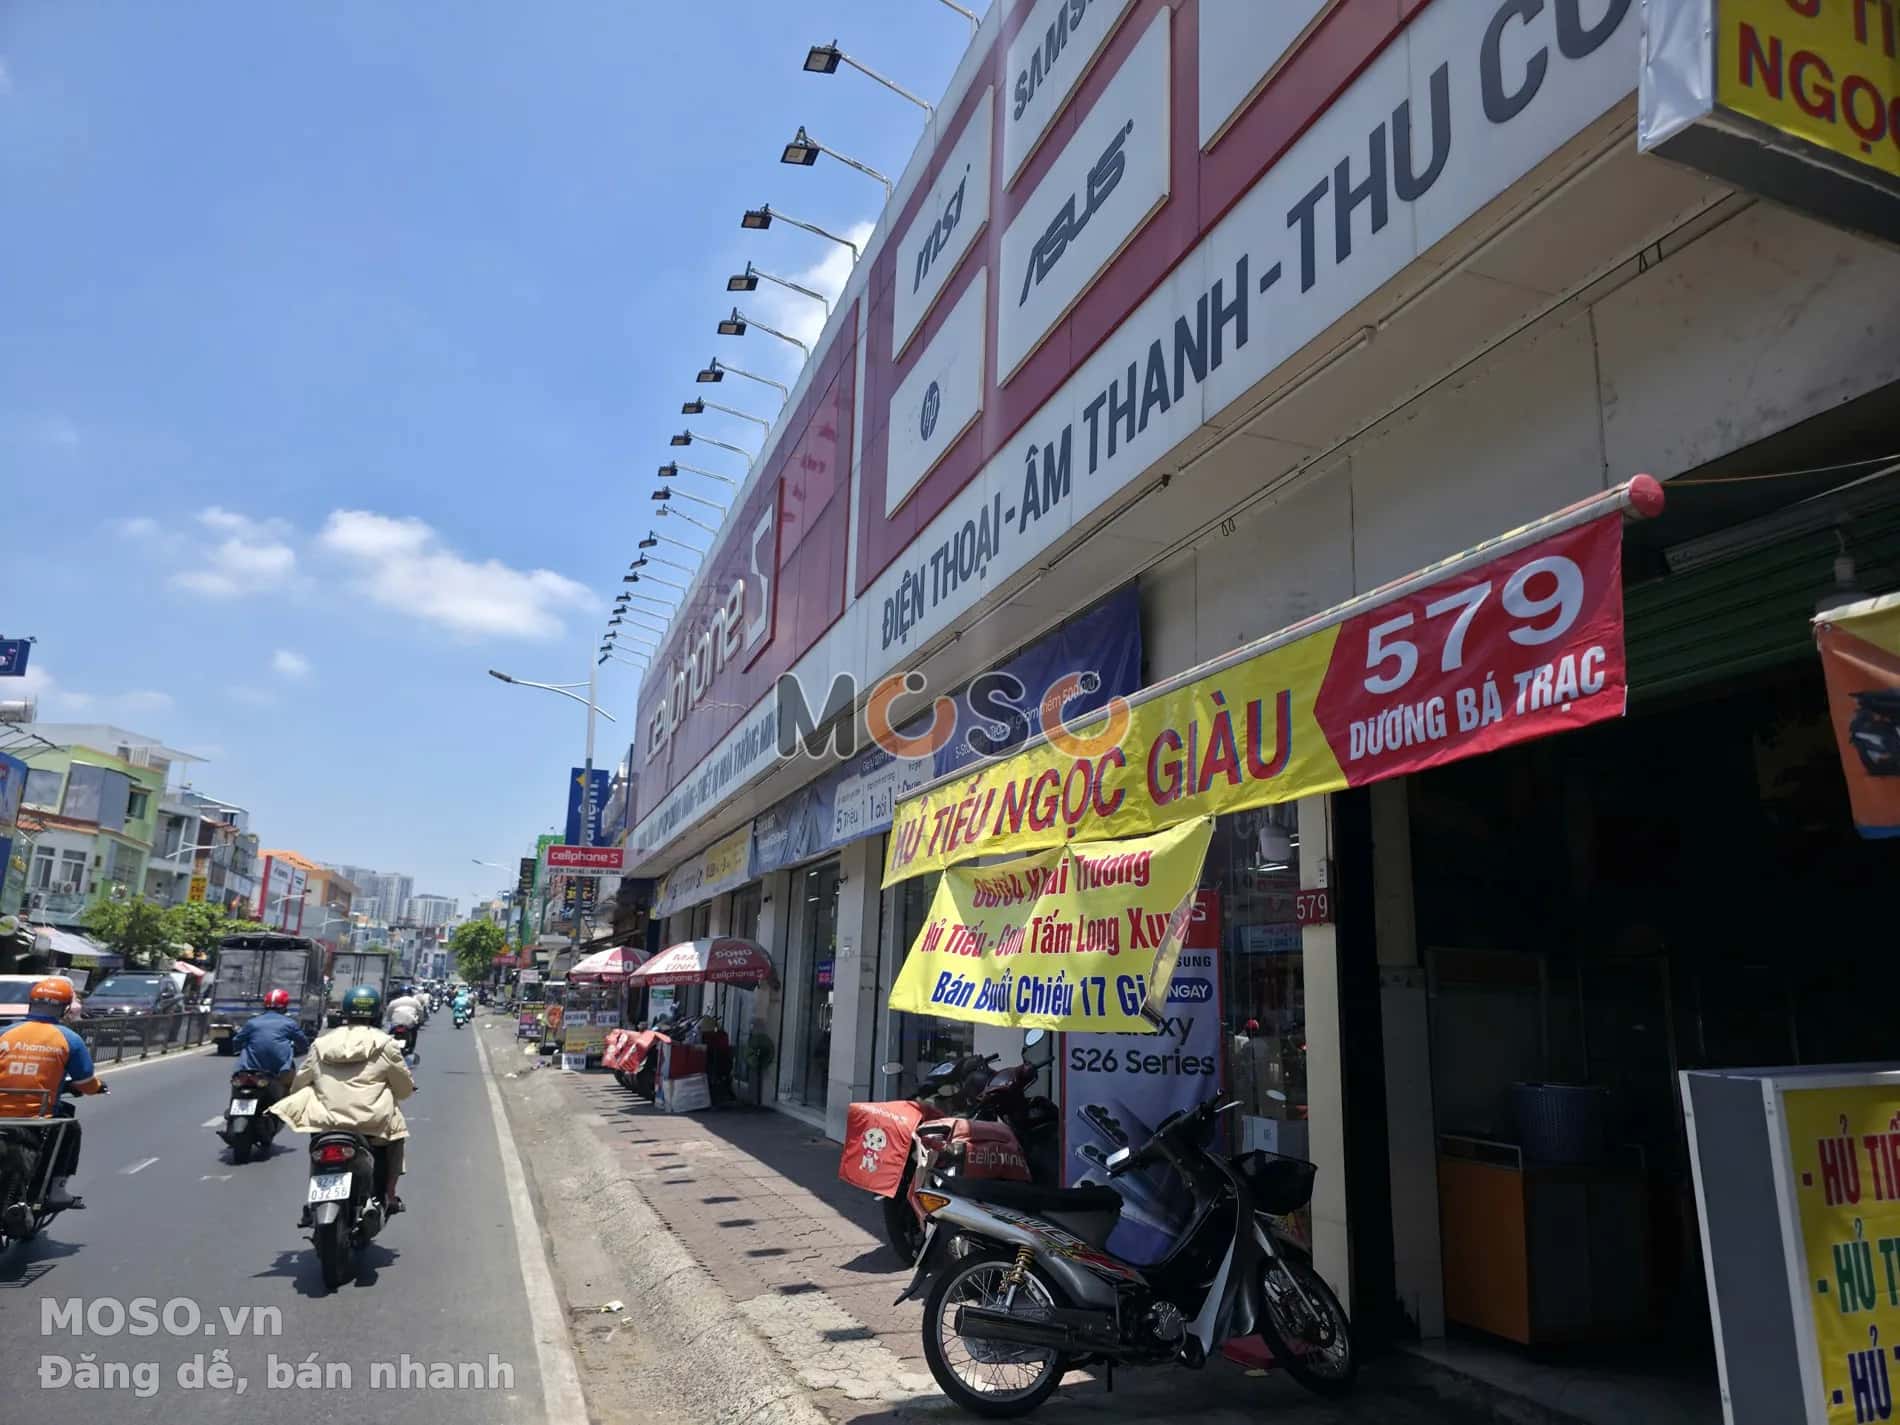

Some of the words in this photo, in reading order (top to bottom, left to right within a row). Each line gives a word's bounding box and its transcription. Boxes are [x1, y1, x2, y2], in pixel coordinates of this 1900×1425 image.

[1014, 0, 1093, 121] SAMS
[1738, 22, 1900, 154] NGỌ
[913, 163, 970, 295] msi
[1019, 126, 1127, 307] ASUS
[882, 566, 926, 650] ĐIỆN
[930, 492, 1000, 608] THOẠI
[1019, 424, 1071, 534] ÂM
[1083, 254, 1248, 474] THANH
[1287, 61, 1451, 293] THU
[1363, 555, 1585, 695] 579
[1350, 696, 1447, 760] DƯƠNG
[1456, 671, 1503, 732] BÁ
[1513, 645, 1605, 715] TRẠC
[891, 795, 928, 871] HỦ
[927, 772, 995, 857] TIẾU
[993, 745, 1126, 839] NGỌC
[1147, 689, 1292, 807] GIÀU
[1074, 850, 1152, 892] Trương
[1297, 894, 1328, 920] 579
[921, 917, 946, 953] Hủ
[944, 919, 988, 958] Tiếu
[995, 923, 1026, 957] Cơm
[1031, 909, 1072, 954] Tấm
[1076, 914, 1120, 958] Long
[1176, 955, 1212, 967] SUNG
[931, 971, 976, 1004] Bán
[976, 968, 1012, 1015] Buổi
[1016, 970, 1073, 1017] Chiều
[1081, 976, 1107, 1017] 17
[1117, 974, 1147, 1017] Gi
[1169, 984, 1209, 998] NGAY
[1071, 1049, 1118, 1072] S26
[1125, 1049, 1215, 1077] Series
[1818, 1113, 1861, 1206] HỦ
[1832, 1218, 1876, 1313] HỦ
[1848, 1325, 1892, 1423] HỦ
